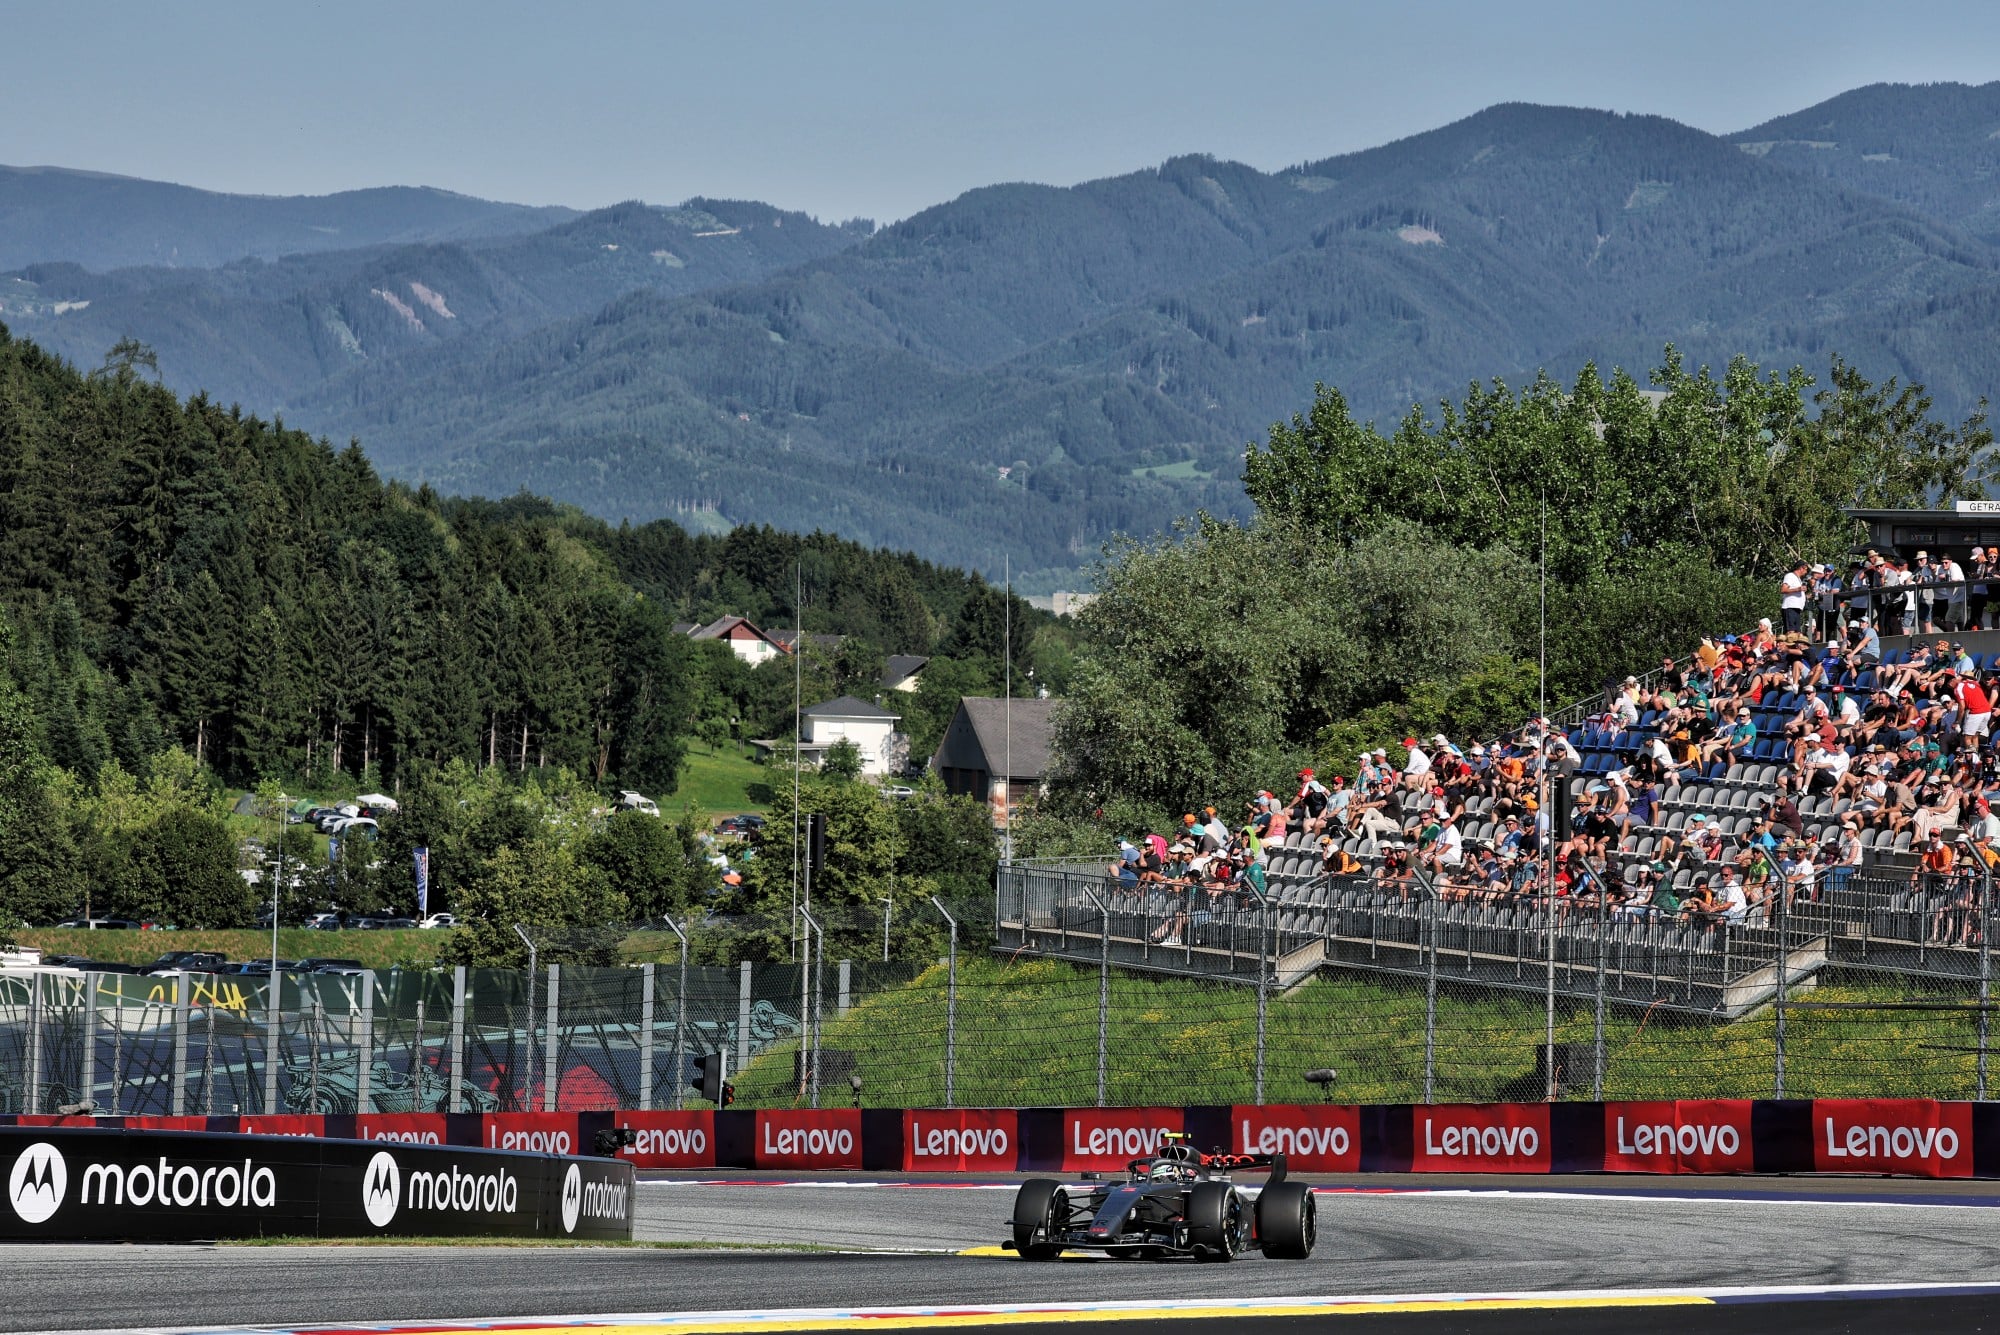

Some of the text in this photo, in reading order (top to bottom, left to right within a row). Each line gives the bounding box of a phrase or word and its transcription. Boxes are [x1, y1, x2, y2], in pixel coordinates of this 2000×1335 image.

[492, 1125, 570, 1154] Lenovo
[624, 1123, 706, 1154] Lenovo
[765, 1123, 852, 1155] Lenovo
[914, 1123, 1007, 1155] Lenovo
[1074, 1121, 1172, 1155] Lenovo
[1242, 1120, 1349, 1155] Lenovo
[1425, 1119, 1538, 1156] Lenovo
[1617, 1117, 1739, 1155] Lenovo
[1826, 1117, 1958, 1159] Lenovo
[81, 1156, 275, 1207] motorola
[409, 1165, 517, 1213] motorola
[583, 1175, 626, 1220] motorola
